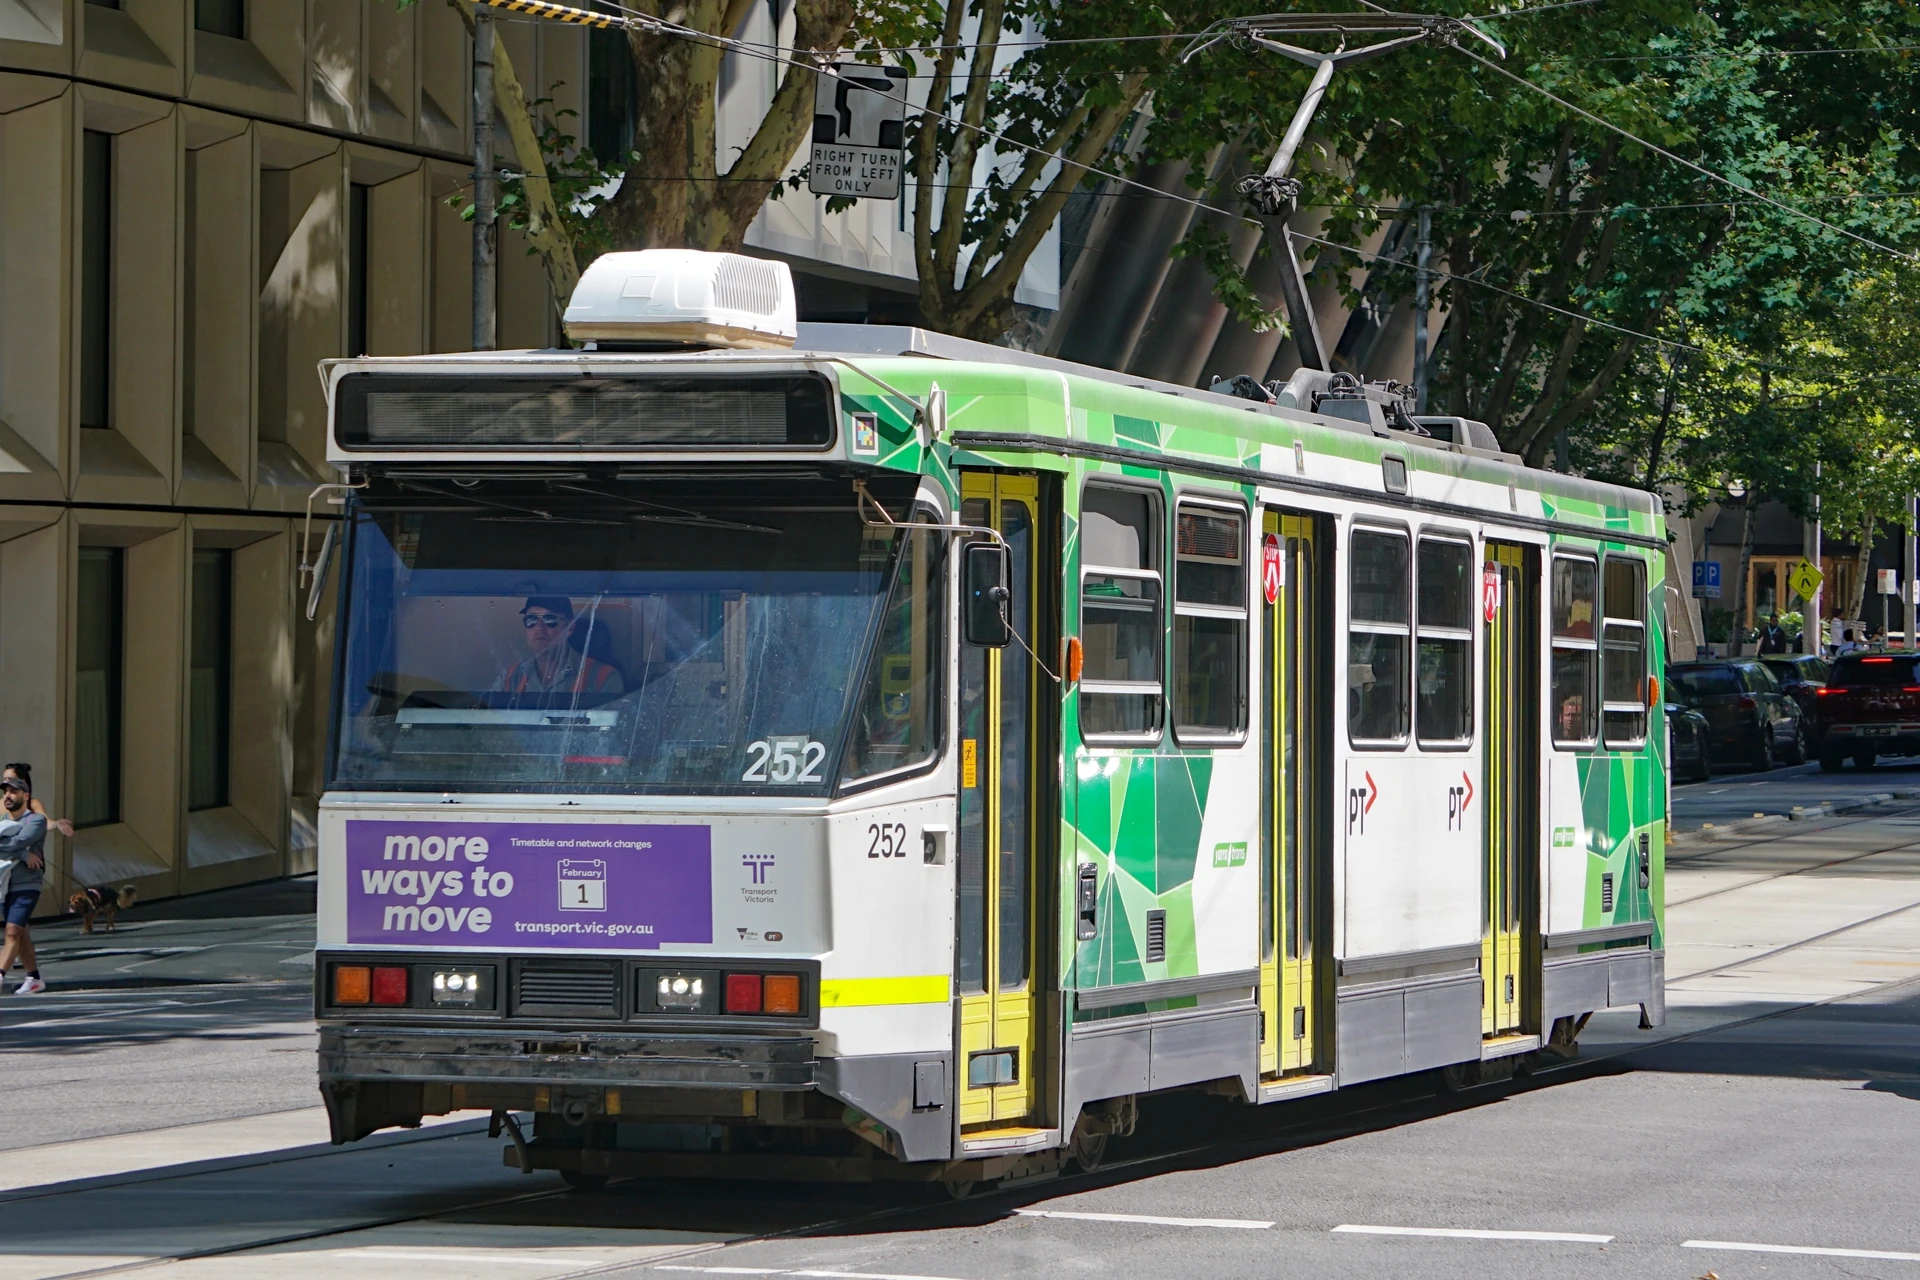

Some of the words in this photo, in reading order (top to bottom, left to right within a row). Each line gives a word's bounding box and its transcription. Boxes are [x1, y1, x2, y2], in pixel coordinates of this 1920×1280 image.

[814, 149, 855, 163] RIGHT
[861, 153, 898, 166] TURN
[815, 163, 851, 177] FROM
[861, 167, 894, 180] LEFT
[835, 179, 872, 192] ONLY
[1265, 546, 1279, 562] STOP
[1709, 566, 1717, 582] P
[741, 740, 826, 783] 252
[383, 835, 489, 862] more
[510, 838, 555, 848] Timetable
[556, 838, 574, 848] and
[575, 839, 613, 848] network
[613, 840, 652, 850] changes
[867, 823, 907, 859] 252
[562, 868, 602, 879] February
[361, 869, 464, 905] ways
[471, 866, 514, 897] to
[577, 883, 589, 904] 1
[740, 887, 778, 896] Transport
[744, 895, 774, 903] Victoria
[382, 905, 492, 933] move
[514, 921, 654, 937] transport.vic.gov.au
